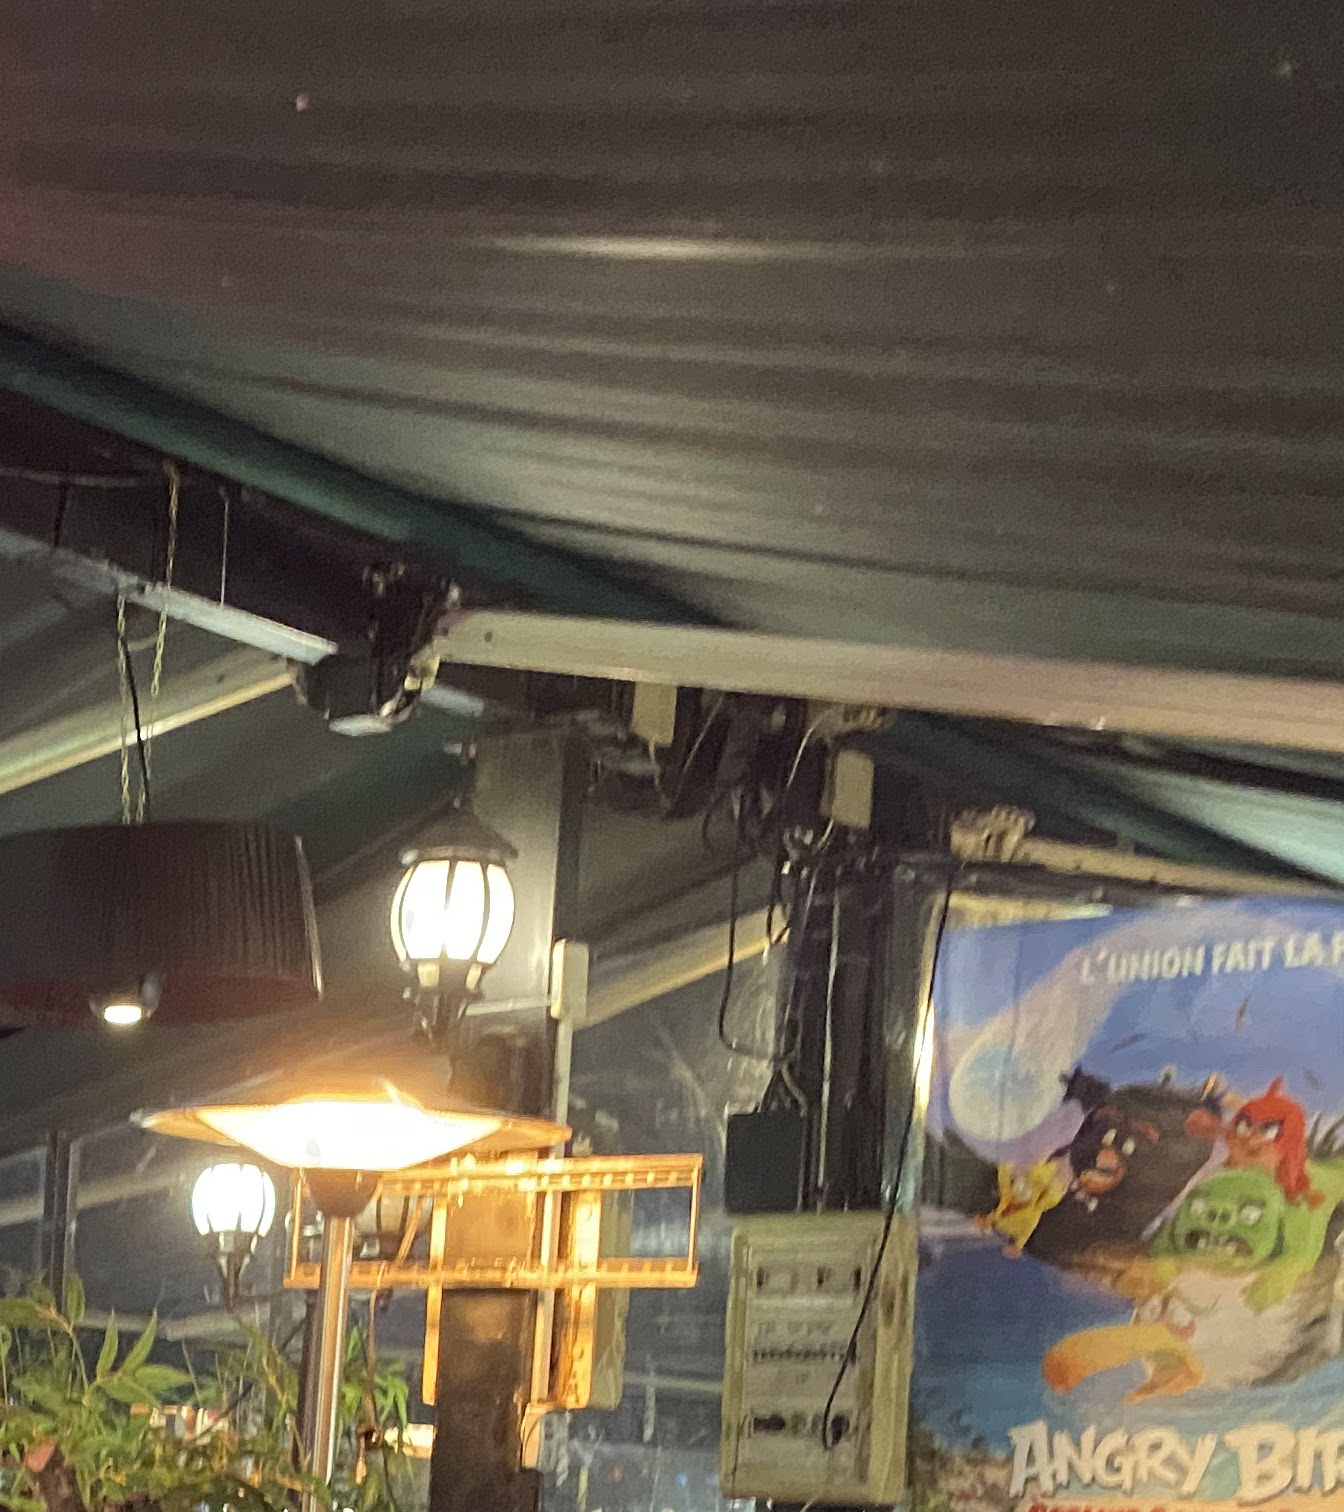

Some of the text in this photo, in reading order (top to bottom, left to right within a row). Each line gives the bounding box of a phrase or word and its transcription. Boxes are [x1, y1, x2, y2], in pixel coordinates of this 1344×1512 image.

[1080, 944, 1205, 983] L'UNION
[1213, 937, 1274, 975] FAIT
[1284, 931, 1323, 968] LA
[1009, 1420, 1216, 1498] ANGRY
